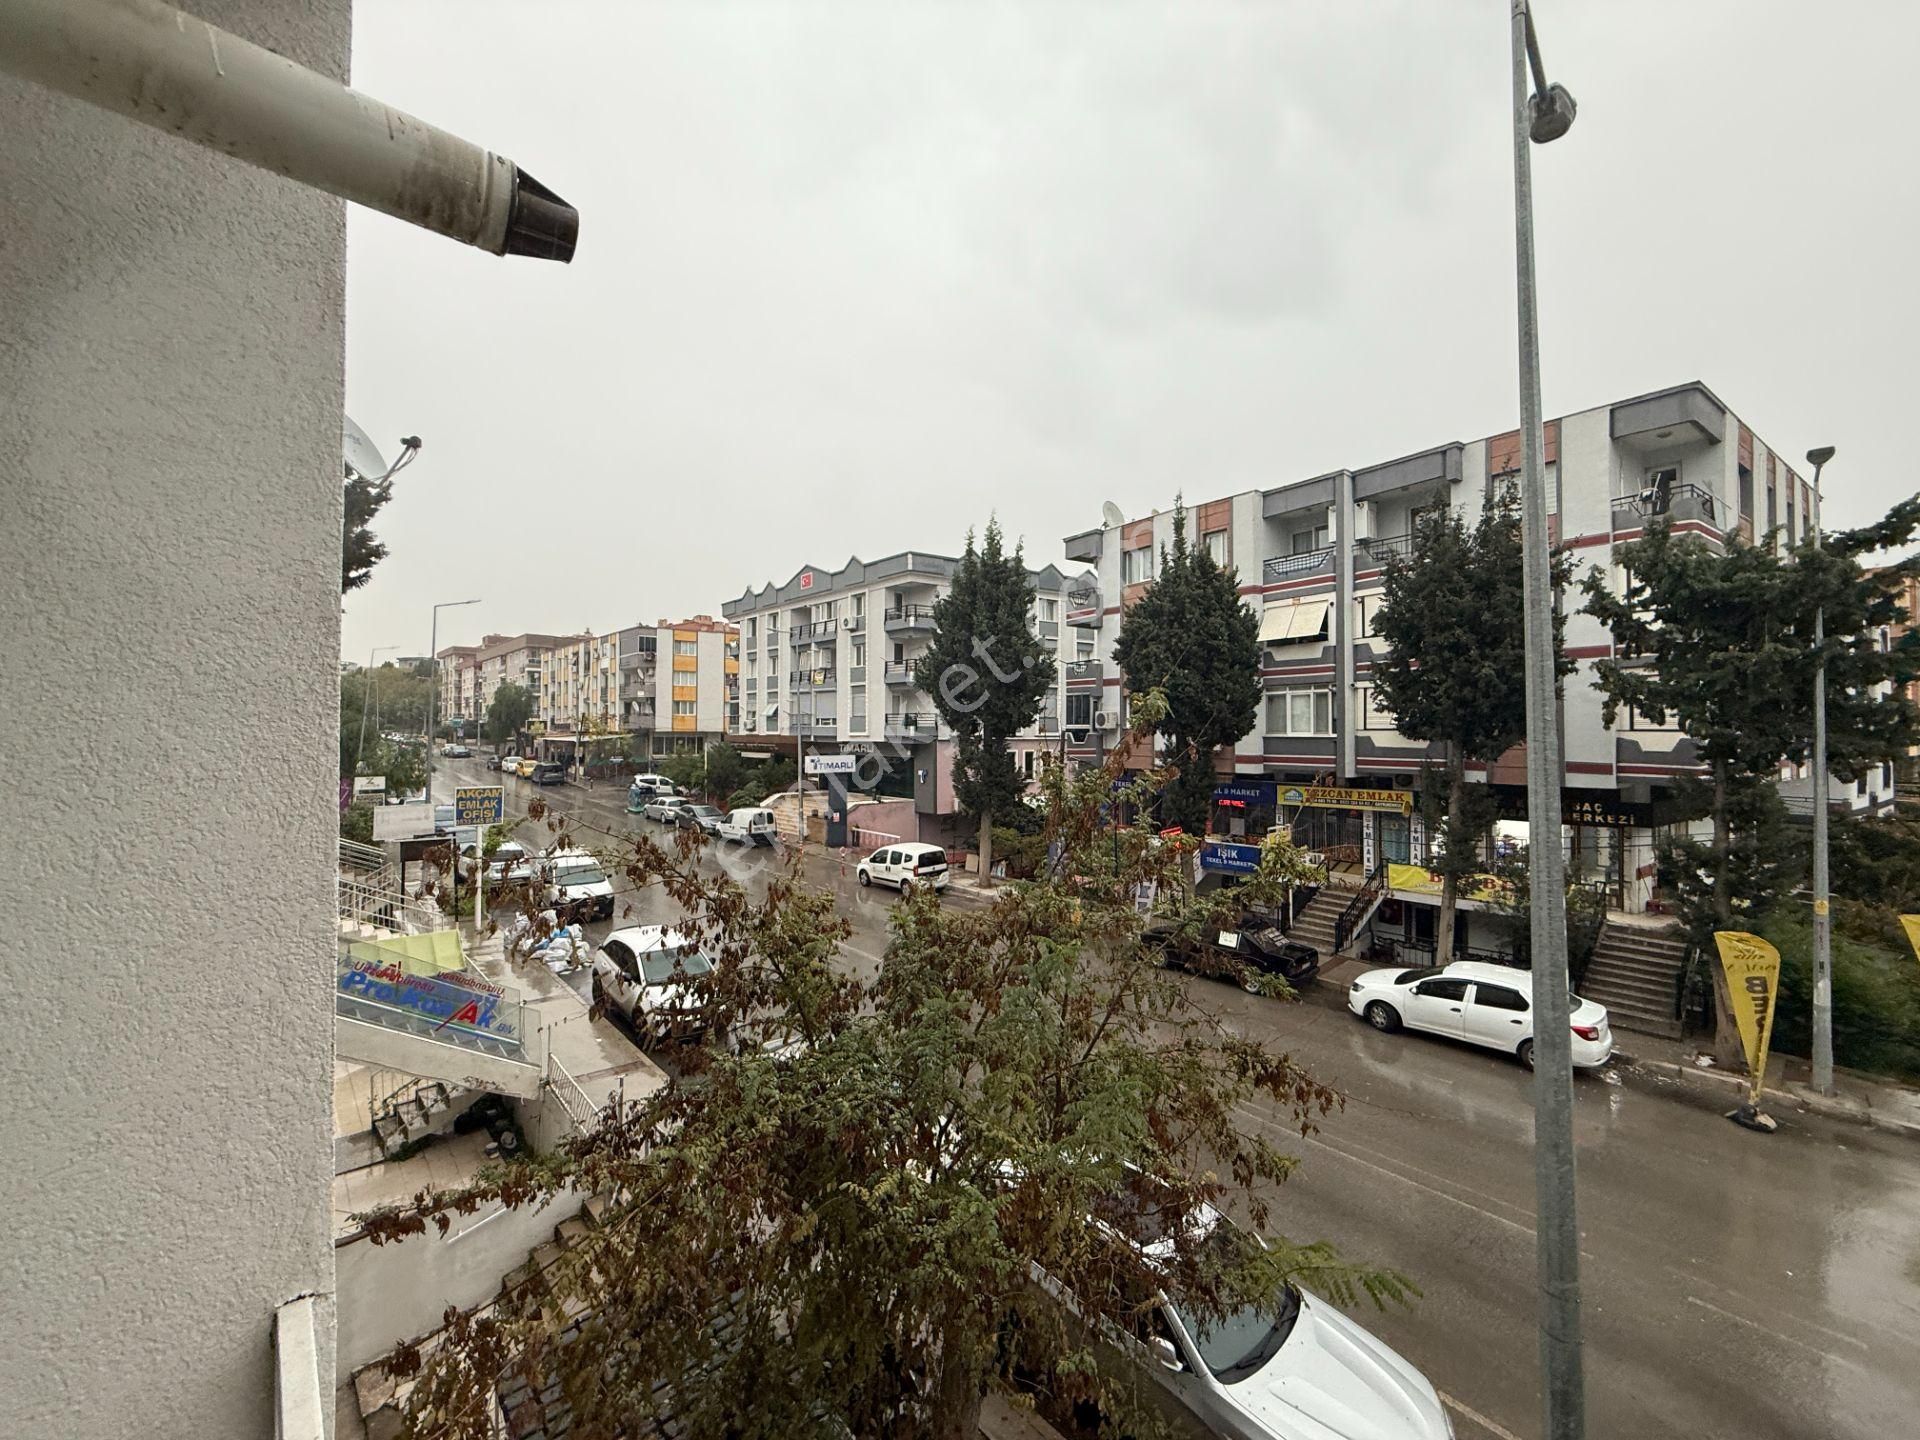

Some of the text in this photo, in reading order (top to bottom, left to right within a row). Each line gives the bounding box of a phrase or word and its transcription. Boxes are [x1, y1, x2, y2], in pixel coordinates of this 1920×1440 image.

[1230, 788, 1260, 797] MARKET
[1304, 787, 1353, 800] TEZCAN
[1357, 792, 1405, 802] EMLAK
[458, 799, 499, 810] EMLAK
[1566, 812, 1635, 825] ERKEZİ
